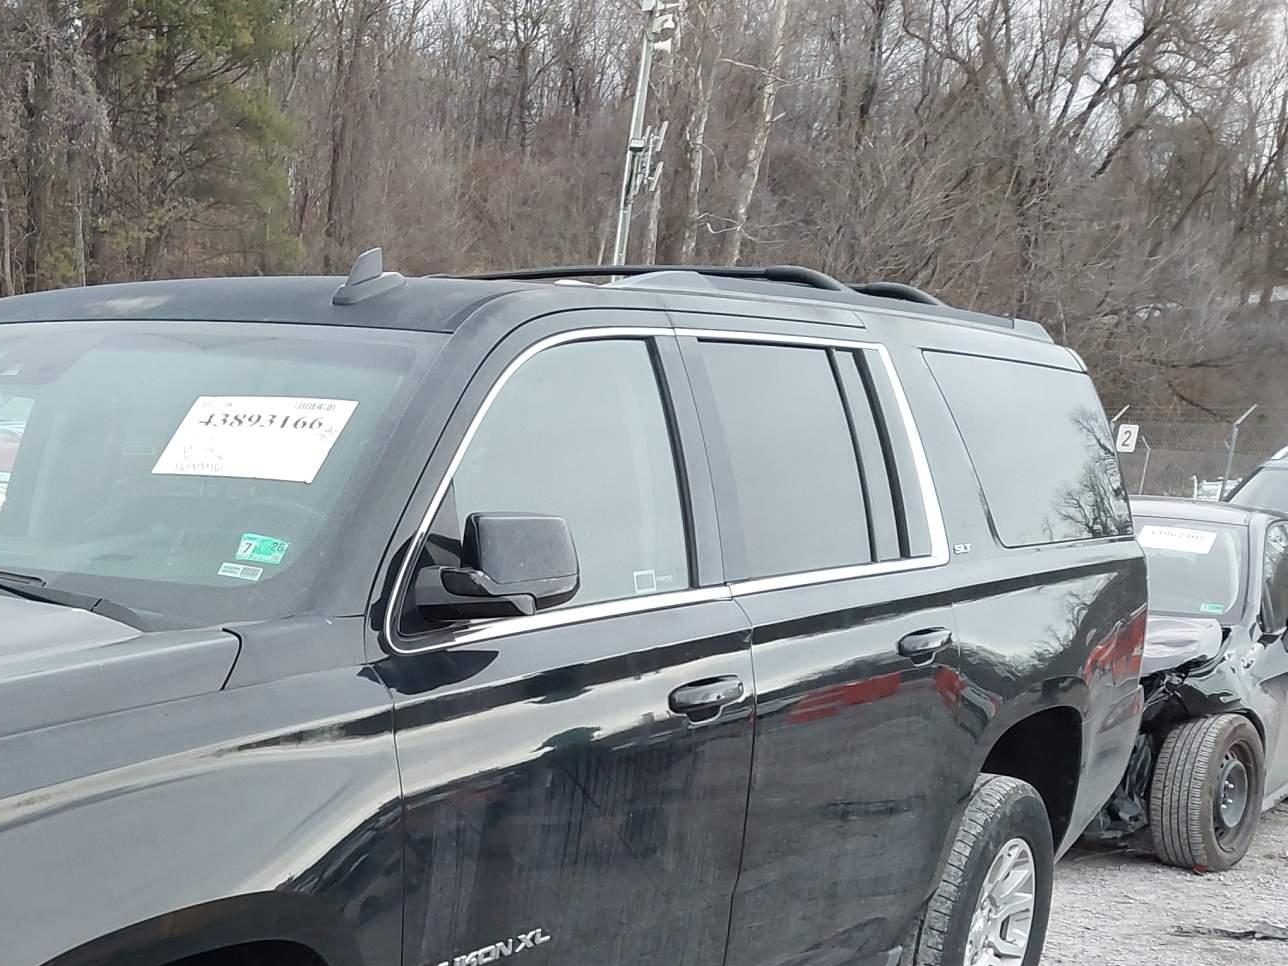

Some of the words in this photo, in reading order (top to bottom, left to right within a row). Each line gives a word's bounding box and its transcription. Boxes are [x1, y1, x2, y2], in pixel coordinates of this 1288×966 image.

[199, 413, 324, 430] 43893166
[1121, 430, 1132, 447] 2
[242, 542, 253, 554] 7
[954, 543, 972, 554] SLT
[514, 928, 551, 953] XL
